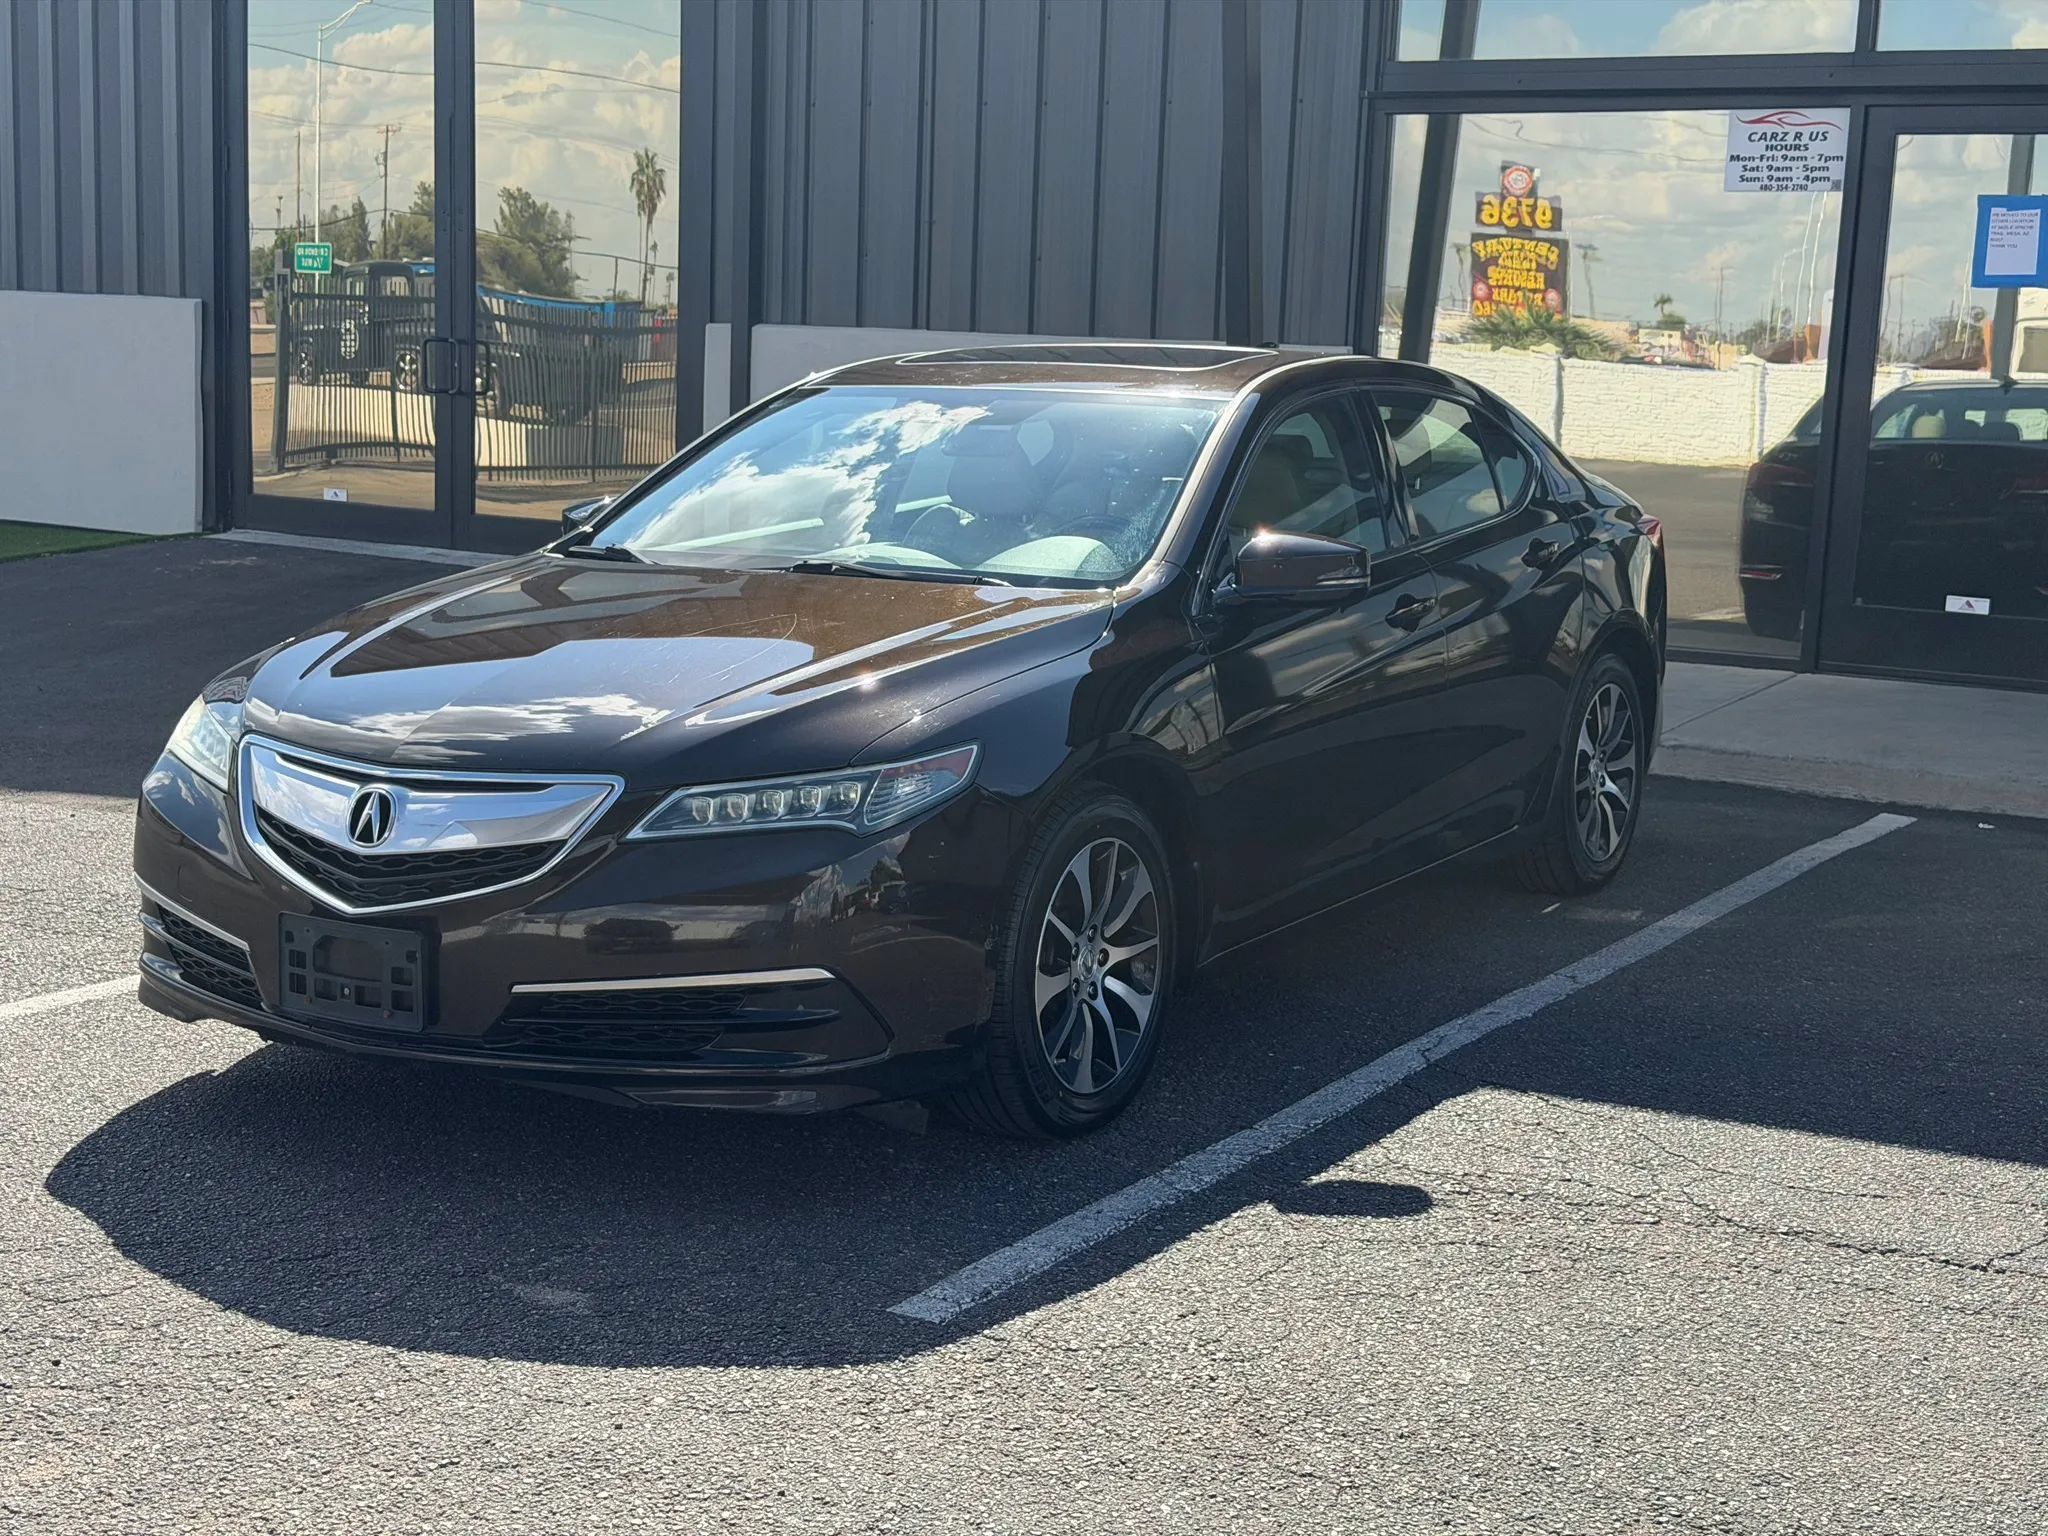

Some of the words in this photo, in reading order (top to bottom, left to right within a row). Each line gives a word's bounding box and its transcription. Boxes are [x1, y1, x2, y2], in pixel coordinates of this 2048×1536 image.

[1747, 131, 1790, 142] CARZ
[1793, 131, 1803, 142] R
[1808, 131, 1829, 142] US
[1765, 143, 1810, 152] HOURS
[1729, 154, 1778, 162] Mon-Fri:
[1781, 154, 1808, 162] 9am
[1817, 154, 1844, 163] 7pm
[1741, 164, 1764, 172] Sat:
[1766, 164, 1793, 172] 9am
[1802, 164, 1829, 173] 5pm
[1738, 174, 1764, 183] Sun:
[1766, 174, 1793, 183] 9am
[1802, 175, 1830, 184] 4pm
